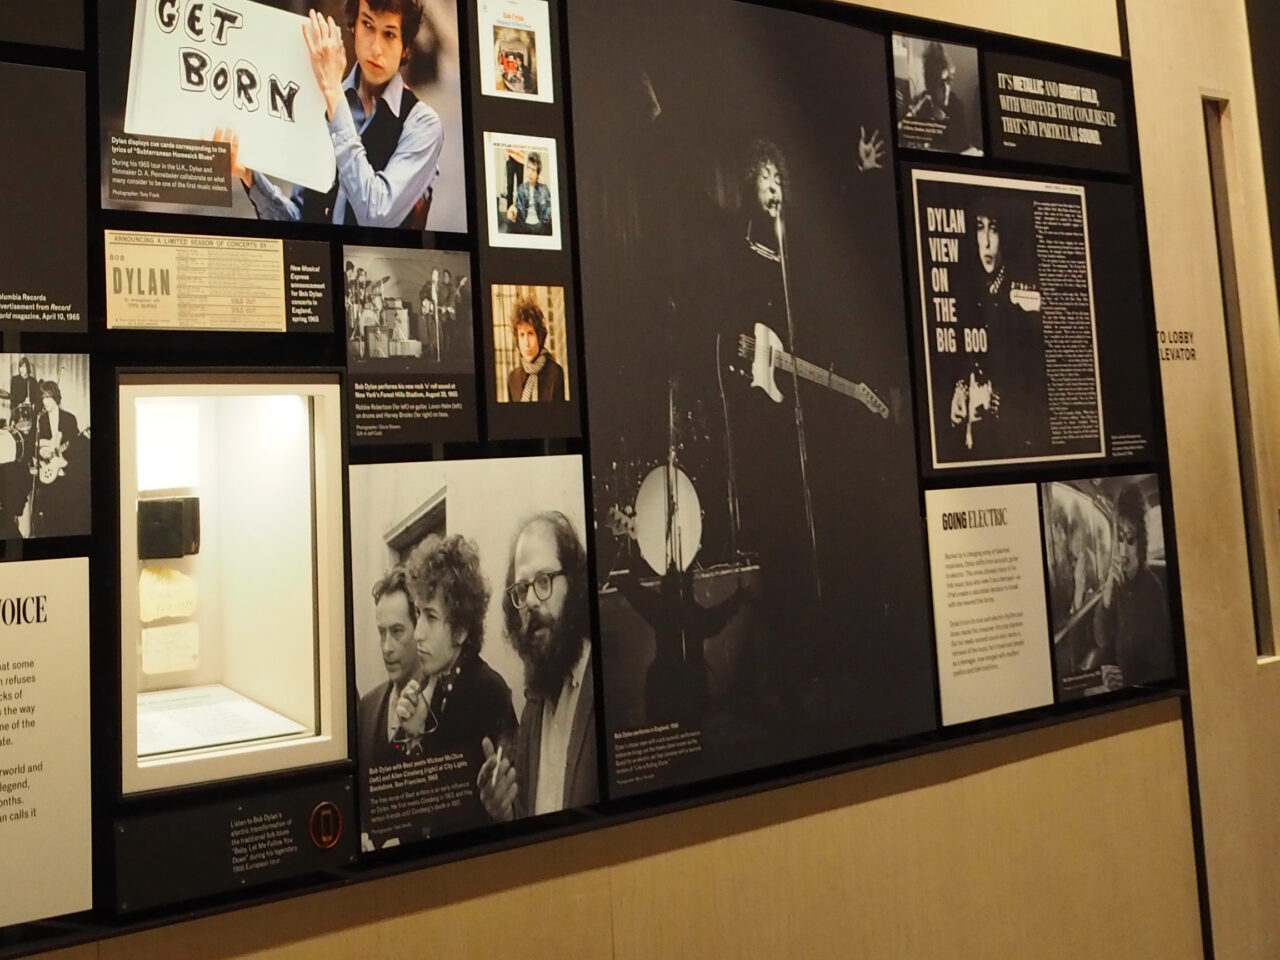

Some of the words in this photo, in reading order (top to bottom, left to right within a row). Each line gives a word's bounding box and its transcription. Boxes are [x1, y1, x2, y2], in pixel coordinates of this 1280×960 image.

[179, 47, 300, 123] BORN
[927, 207, 966, 234] DYLAN
[110, 253, 125, 261] BOB
[928, 237, 959, 263] VIEW
[113, 266, 170, 296] DYLAN
[931, 267, 949, 293] ON
[22, 293, 46, 301] Records
[12, 312, 40, 320] magazine,
[42, 312, 55, 320] April
[933, 297, 958, 322] THE
[936, 327, 957, 353] BIG
[964, 327, 988, 353] BOO
[1168, 331, 1194, 344] LOBBY
[942, 511, 967, 531] GOING
[968, 507, 1008, 529] ELECTRIC
[12, 660, 34, 669] some
[5, 674, 35, 685] refuses
[3, 705, 17, 716] the
[19, 704, 35, 714] way
[11, 719, 19, 729] of
[21, 718, 35, 728] the
[27, 761, 42, 772] and
[0, 778, 29, 793] legend,
